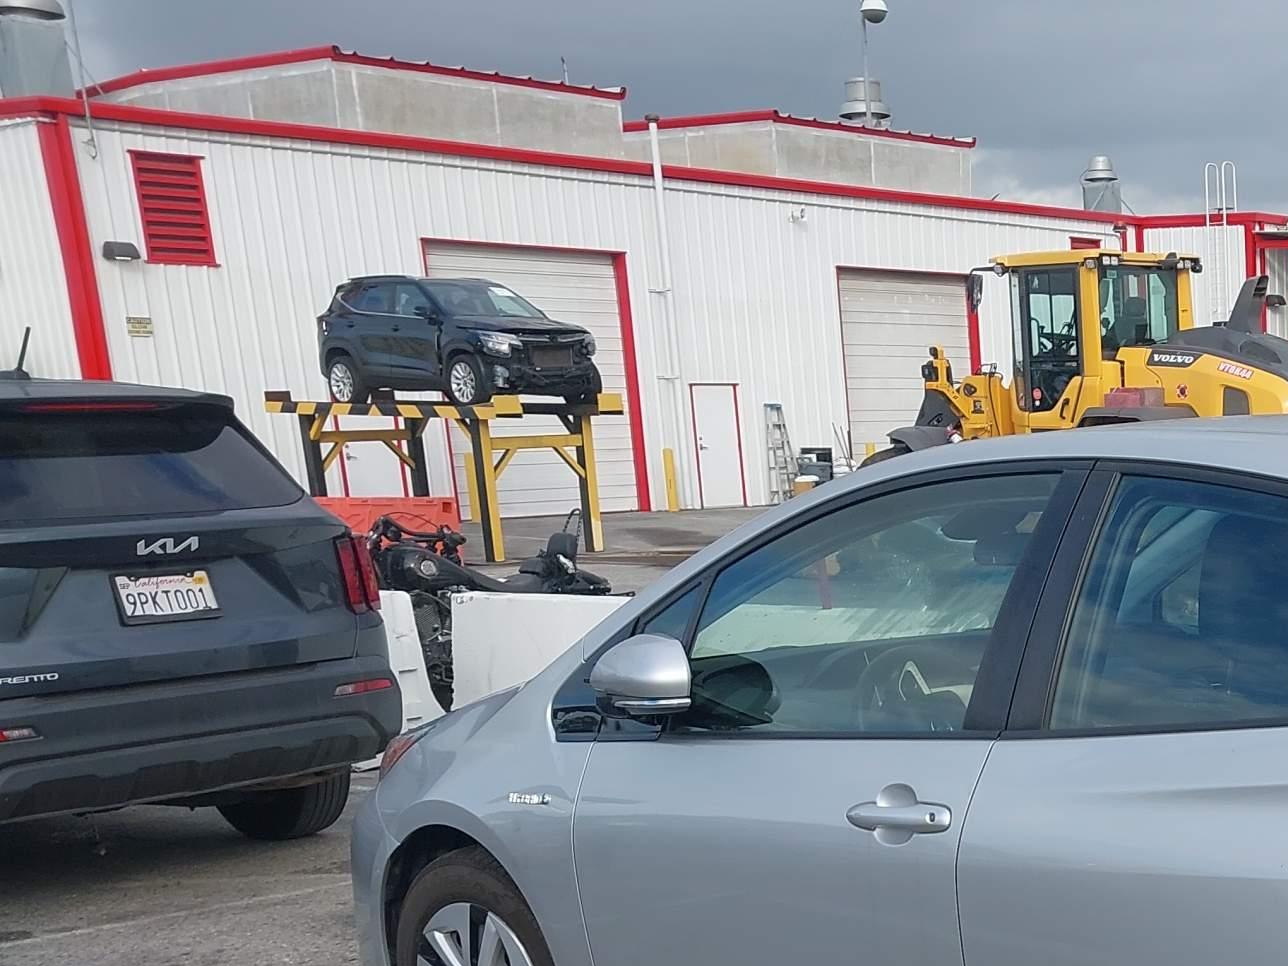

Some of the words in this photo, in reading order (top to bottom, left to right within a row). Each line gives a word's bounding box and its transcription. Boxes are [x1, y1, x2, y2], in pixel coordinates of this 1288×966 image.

[1153, 353, 1194, 364] VOLVO
[137, 536, 199, 555] KIA
[126, 588, 212, 616] 9PKT001
